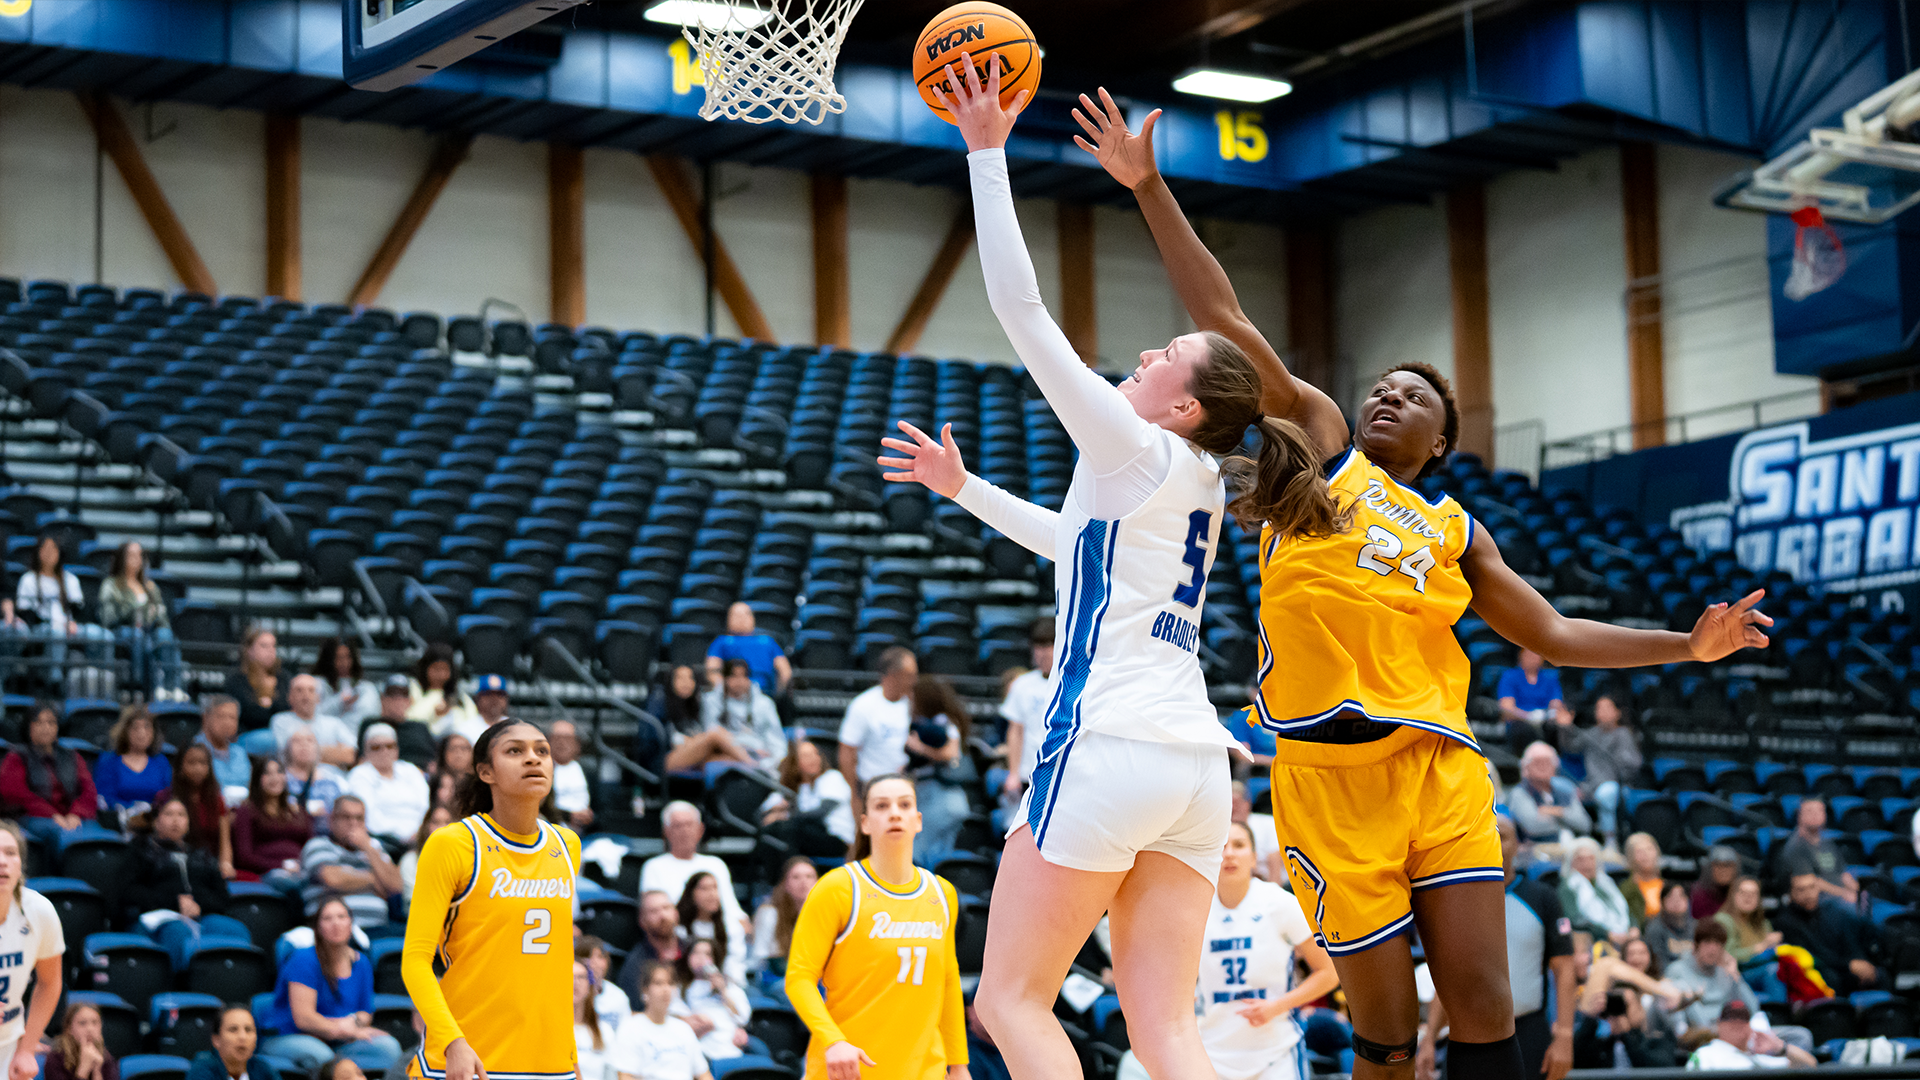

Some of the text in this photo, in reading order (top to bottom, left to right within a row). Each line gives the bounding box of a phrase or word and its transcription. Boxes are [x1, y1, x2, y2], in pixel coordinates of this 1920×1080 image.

[926, 23, 985, 61] NCAA
[1214, 111, 1269, 163] 15
[1172, 507, 1214, 610] 5
[1356, 524, 1436, 595] 24
[489, 867, 571, 899] Runners
[522, 908, 551, 954] 2
[869, 911, 943, 939] Runners
[897, 946, 927, 985] 11
[1221, 957, 1247, 985] 32
